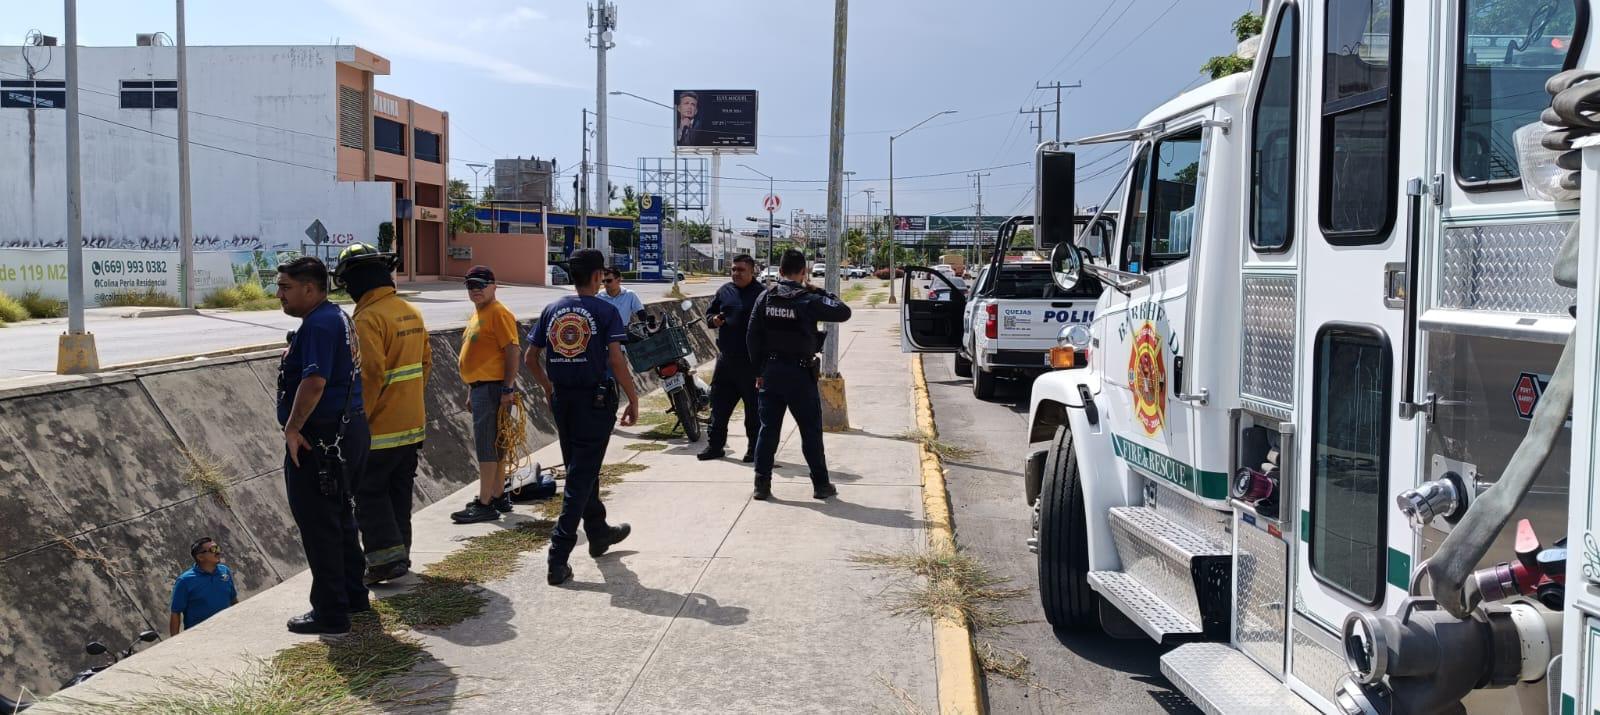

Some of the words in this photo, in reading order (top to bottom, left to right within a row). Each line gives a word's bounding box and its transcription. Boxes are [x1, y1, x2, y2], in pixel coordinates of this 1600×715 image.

[20, 264, 44, 281] 119
[101, 260, 125, 275] (669)
[127, 260, 144, 273] 993
[146, 260, 167, 273] 0382
[100, 279, 119, 287] Colina
